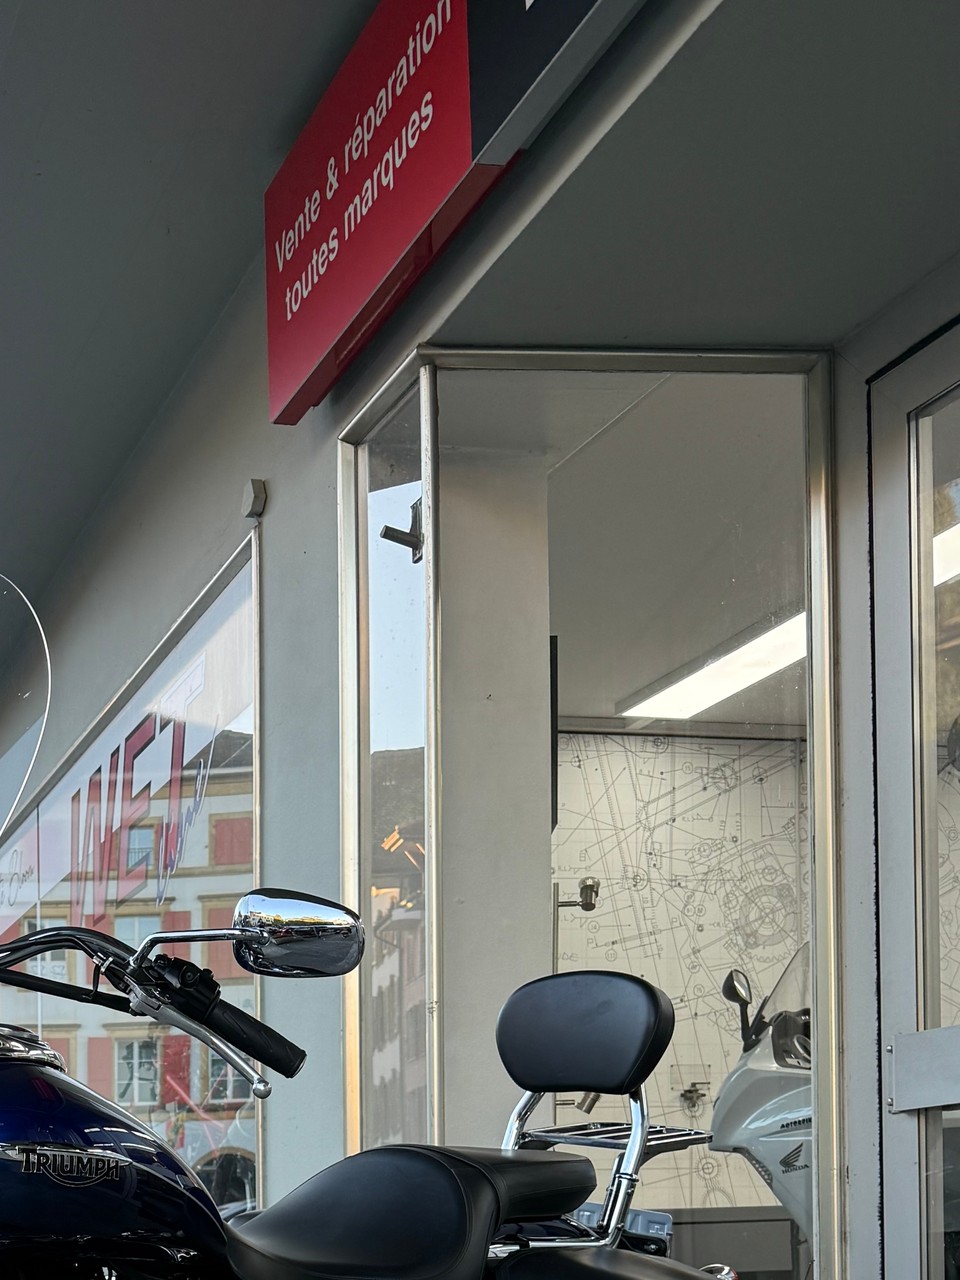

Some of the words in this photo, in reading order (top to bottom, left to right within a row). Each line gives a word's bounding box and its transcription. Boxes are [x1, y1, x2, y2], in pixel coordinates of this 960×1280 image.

[275, 189, 320, 272] Vente
[326, 156, 339, 200] &
[345, 0, 451, 175] réparation
[286, 227, 338, 321] toutes
[344, 91, 433, 241] marques
[16, 1145, 120, 1187] TRIUMPH
[781, 1164, 810, 1174] HONDA
